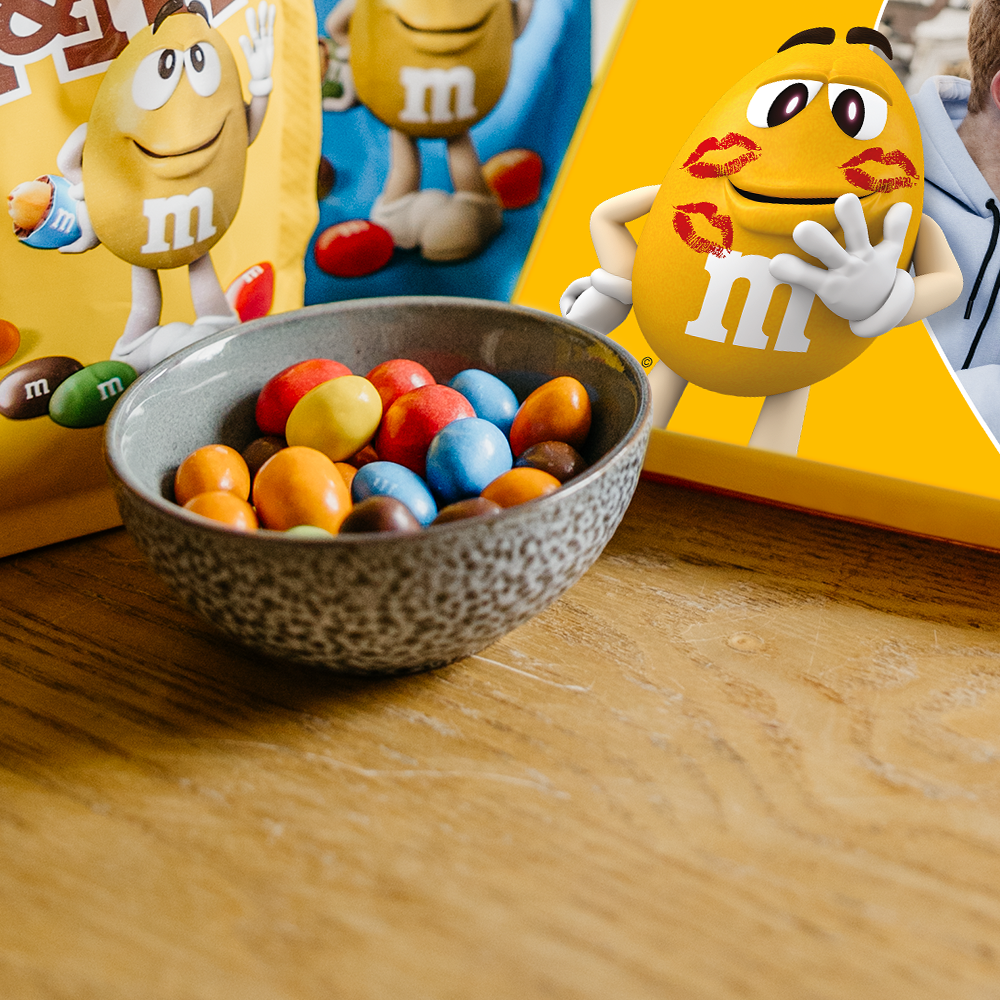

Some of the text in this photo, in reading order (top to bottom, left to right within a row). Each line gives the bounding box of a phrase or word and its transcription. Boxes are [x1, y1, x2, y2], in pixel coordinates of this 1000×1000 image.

[399, 65, 478, 124] m
[51, 207, 77, 234] m
[140, 186, 217, 254] m
[684, 250, 817, 354] m
[24, 377, 51, 400] m
[96, 375, 125, 401] m
